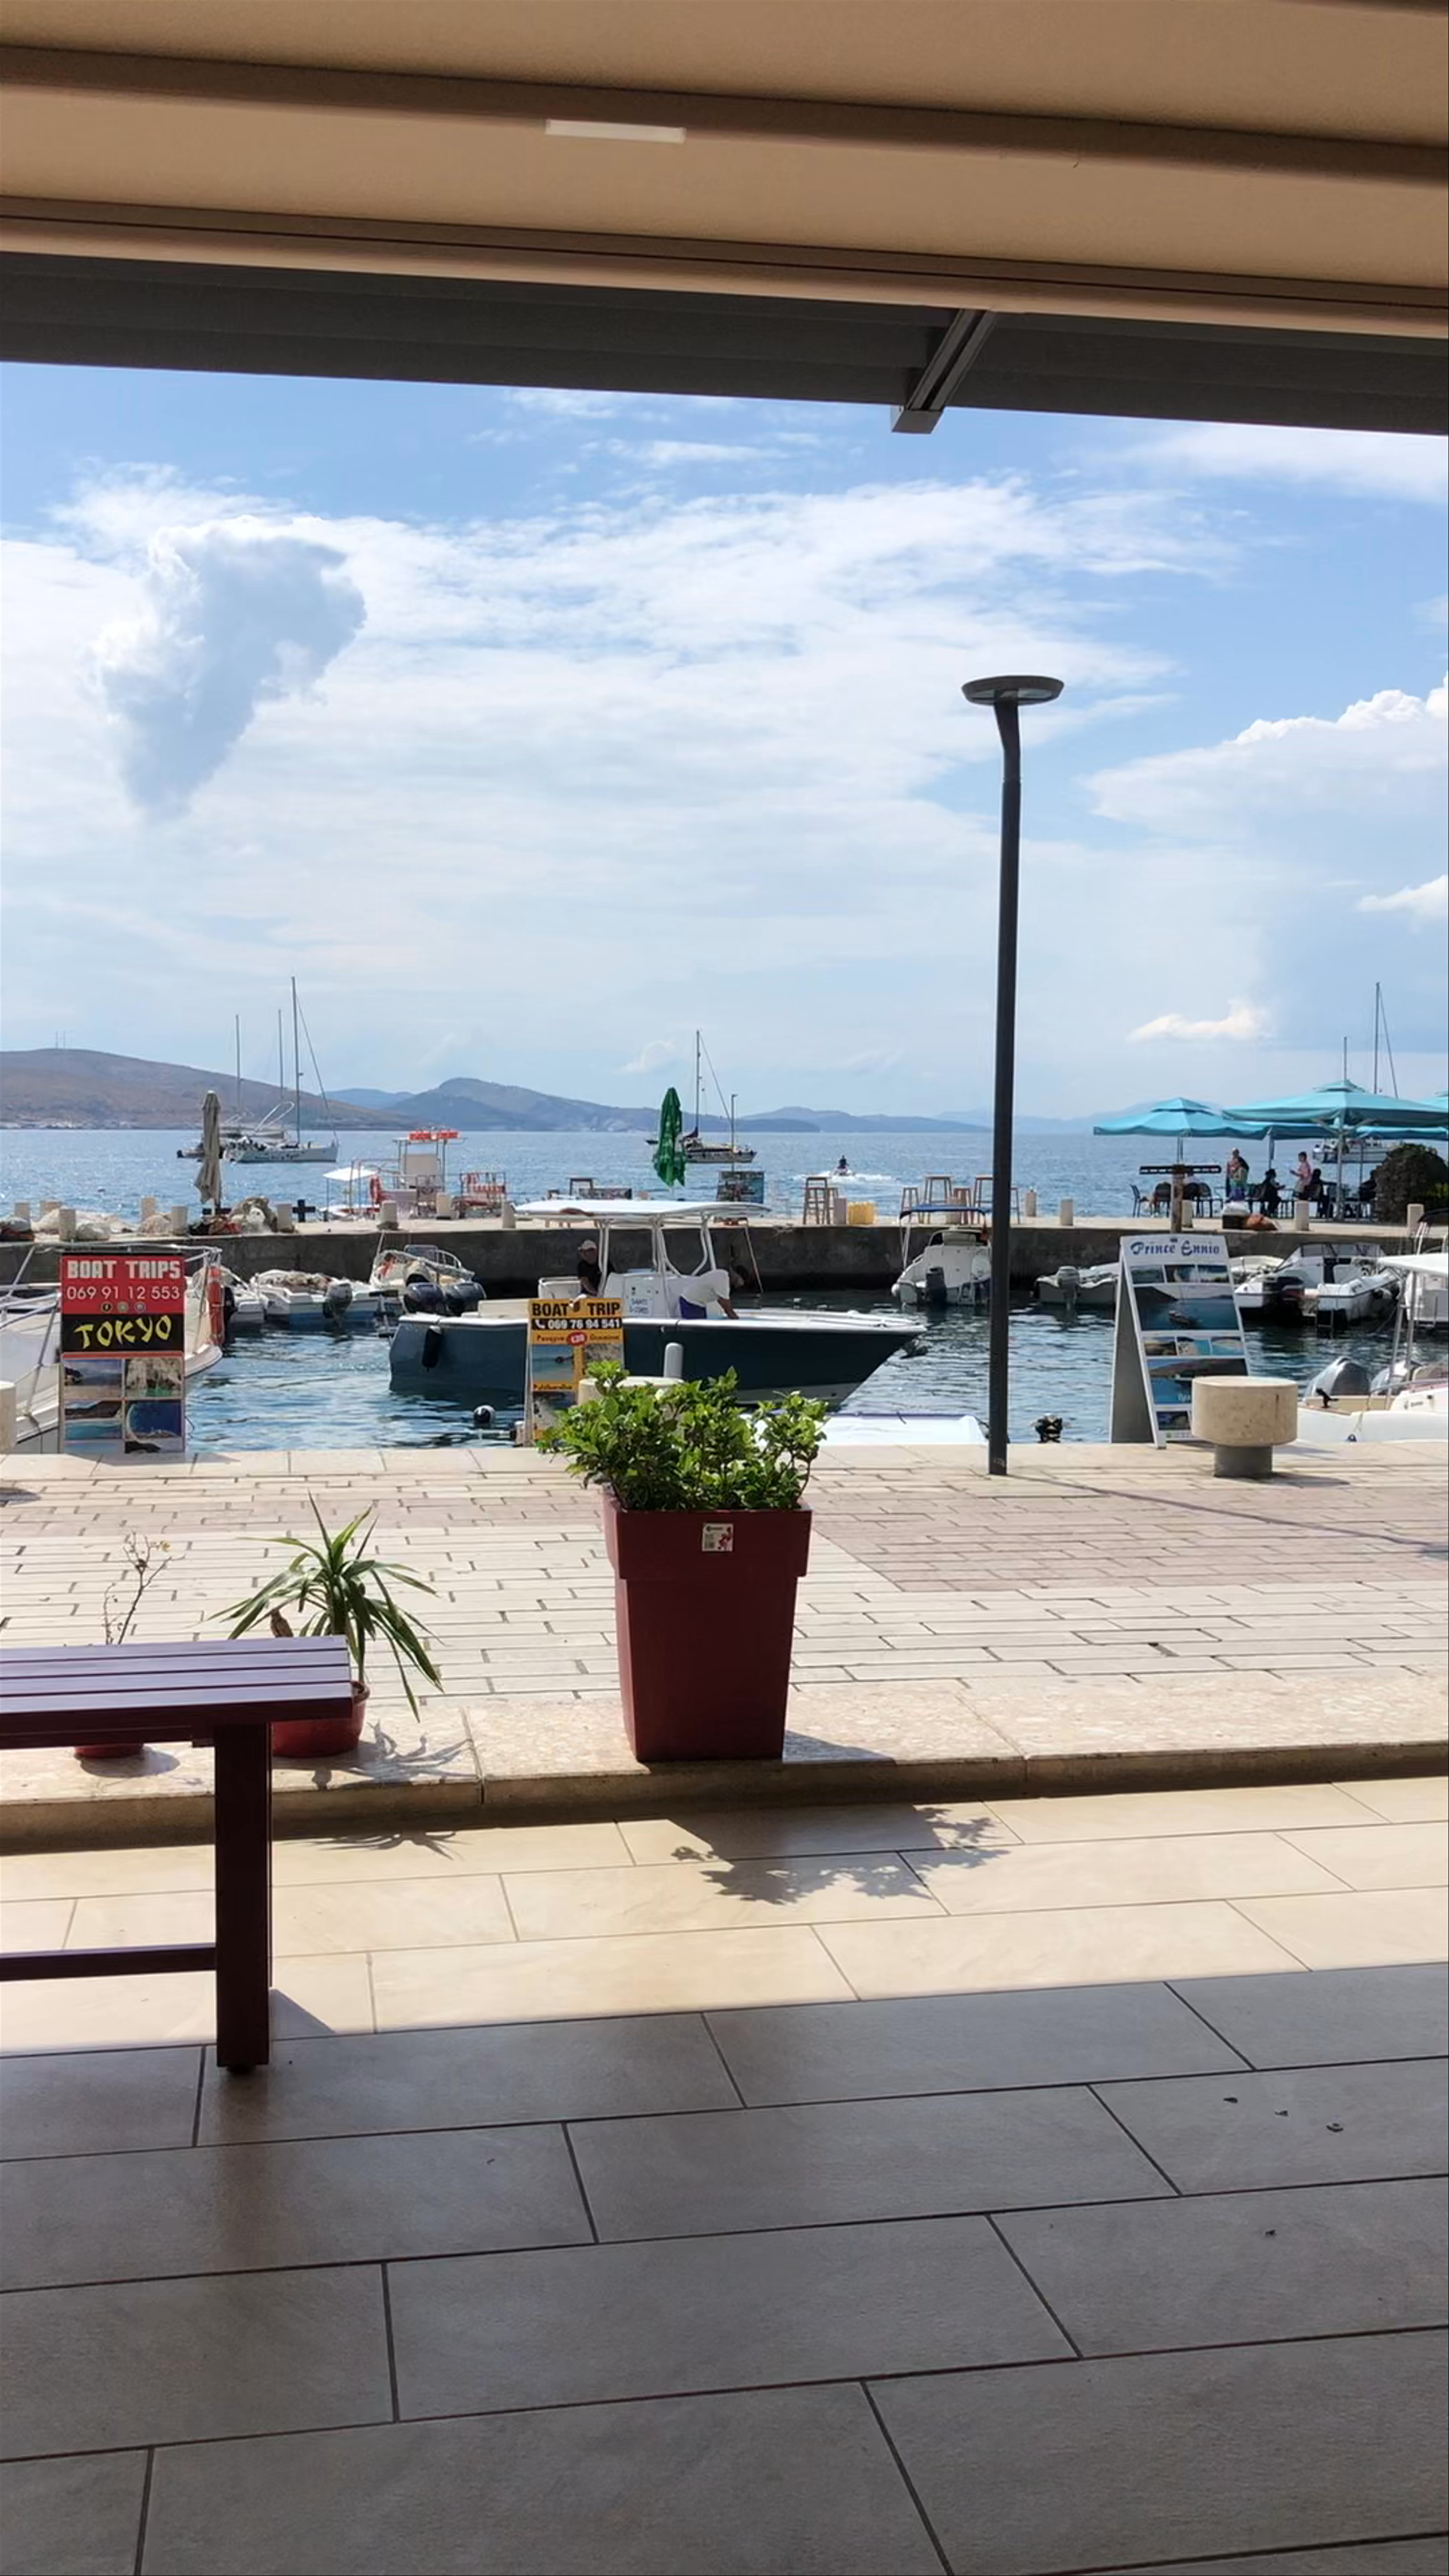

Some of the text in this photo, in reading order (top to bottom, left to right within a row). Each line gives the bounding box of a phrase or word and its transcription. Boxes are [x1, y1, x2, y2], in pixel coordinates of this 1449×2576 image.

[1131, 1240, 1220, 1256] Prince Ennio
[68, 1260, 181, 1278] BOAT TRIPS
[67, 1286, 180, 1299] 069 91 12 553
[532, 1303, 568, 1316] BOAT
[587, 1302, 620, 1315] TRIP
[548, 1320, 567, 1329] 069
[602, 1319, 620, 1328] 541
[74, 1315, 171, 1349] TOKYO
